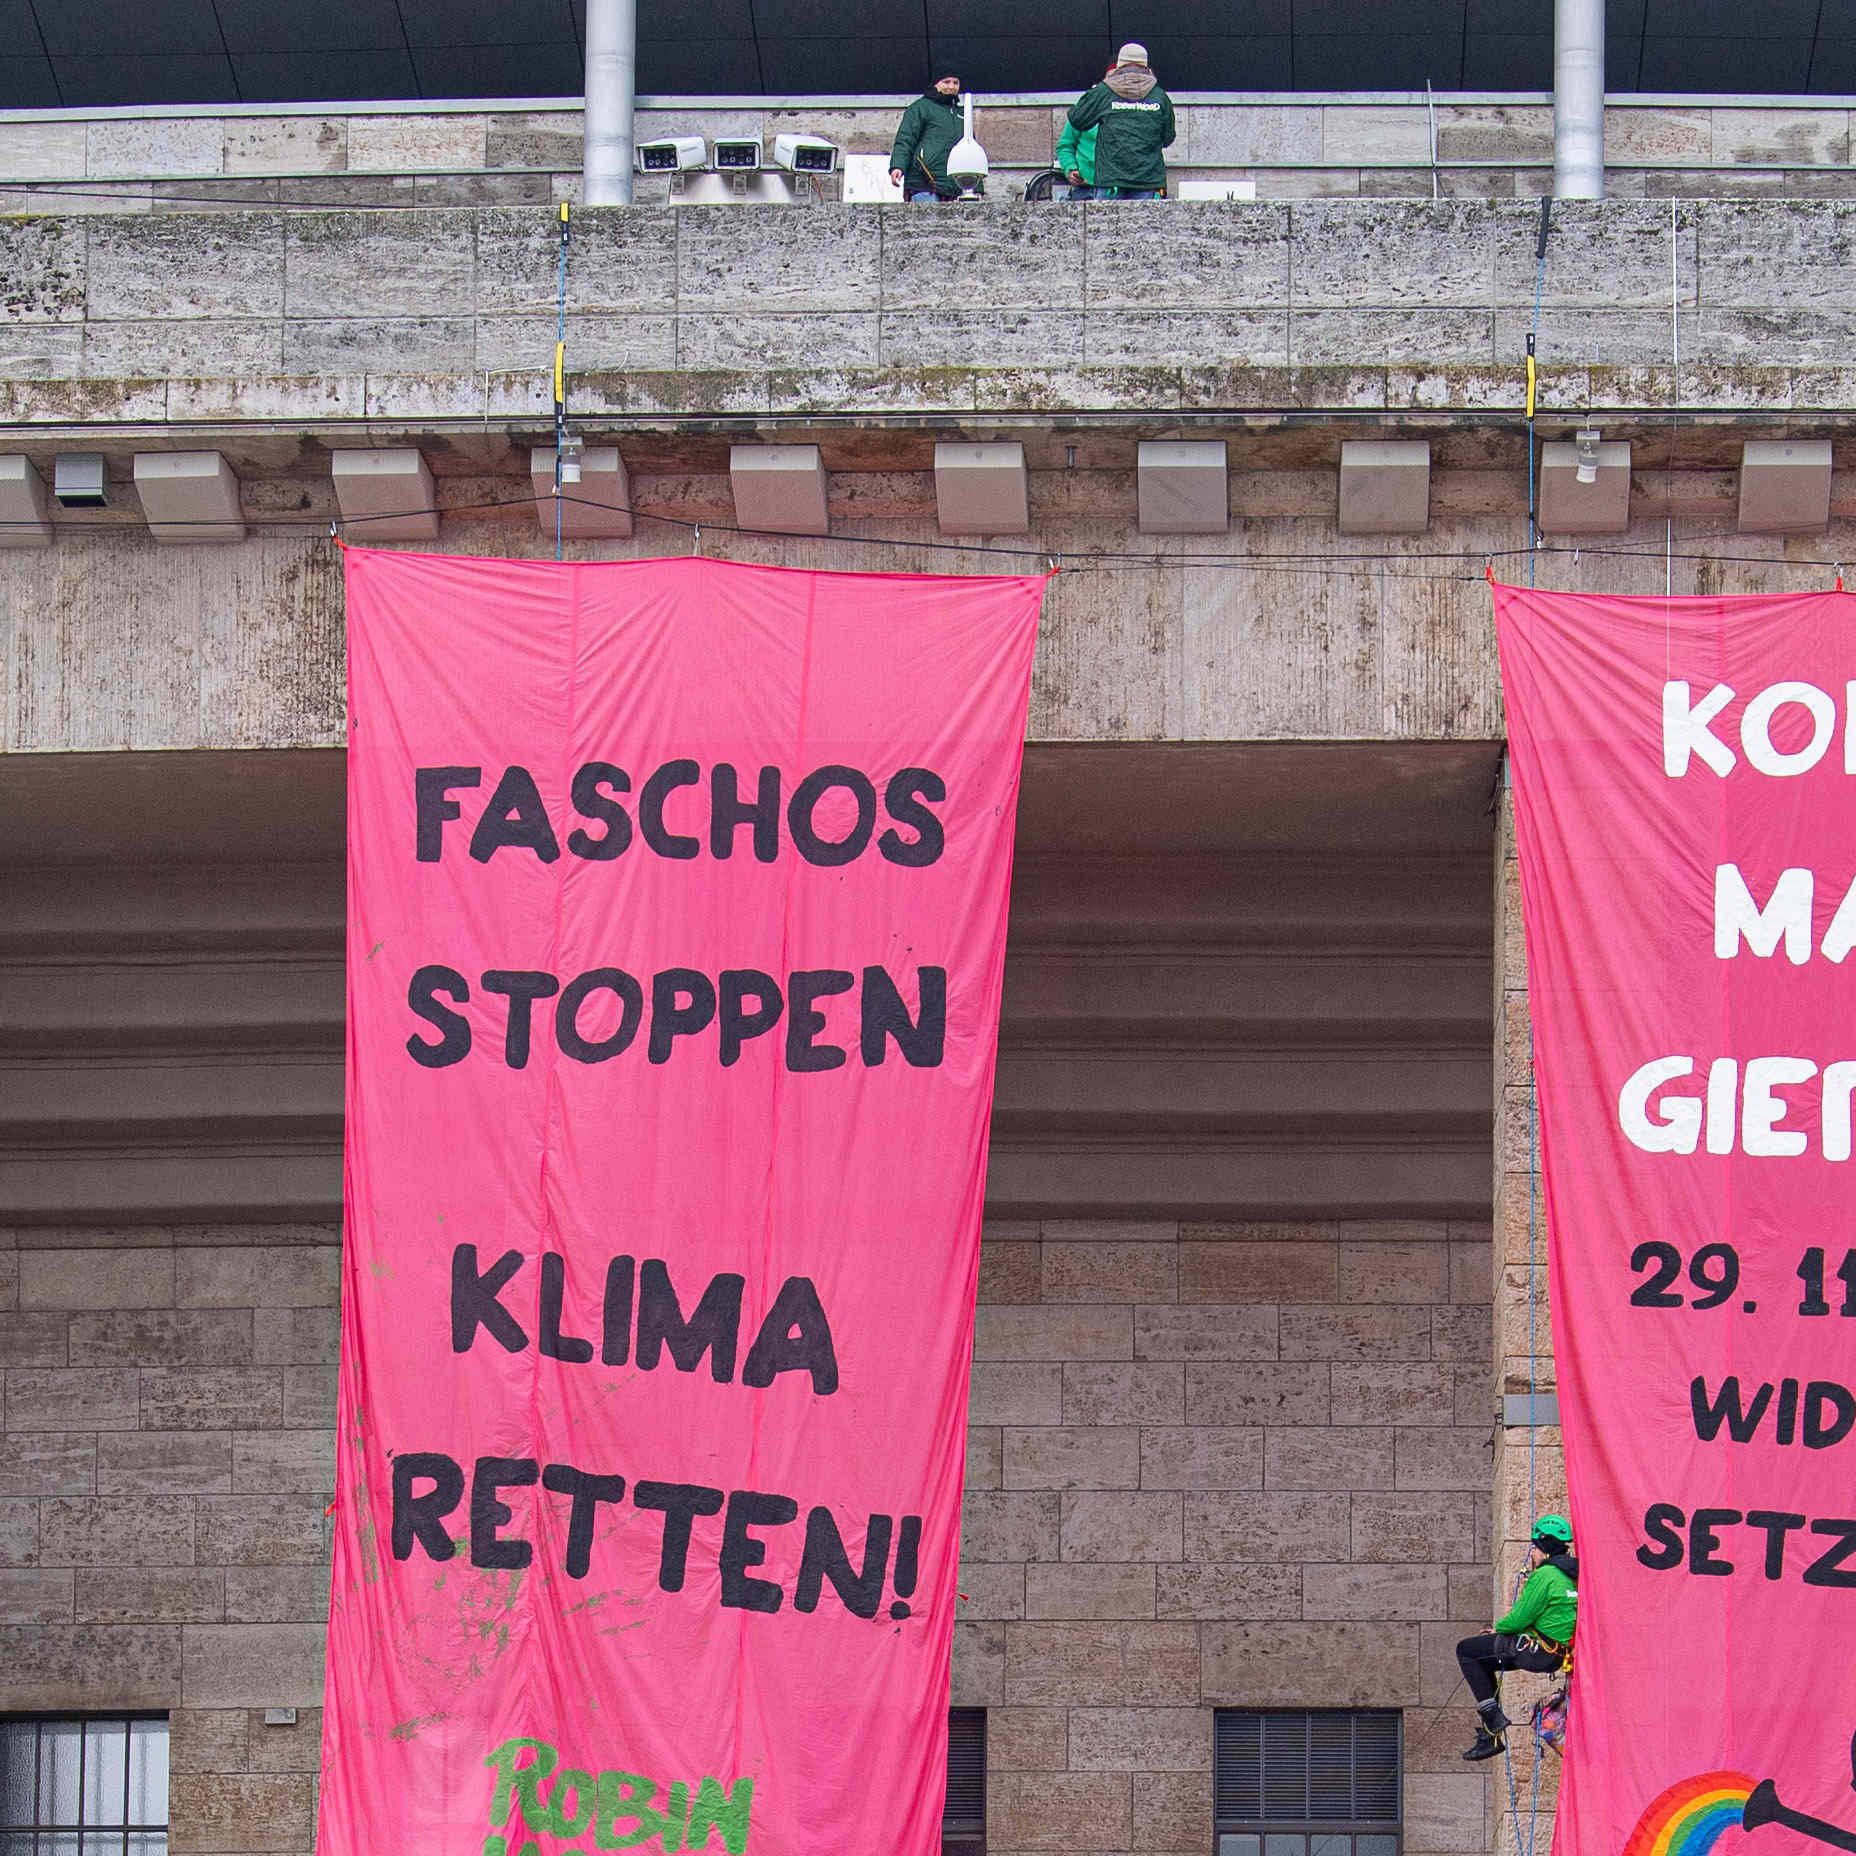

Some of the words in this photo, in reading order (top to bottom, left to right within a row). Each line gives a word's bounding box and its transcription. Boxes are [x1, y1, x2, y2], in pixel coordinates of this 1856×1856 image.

[415, 760, 945, 867] FASCHOS
[406, 964, 946, 1073] STOPPEN
[451, 1243, 839, 1395] KLIMA
[1630, 1241, 1756, 1314] 29.
[390, 1451, 923, 1620] RETTEN!
[483, 1738, 754, 1856] ROBIN
